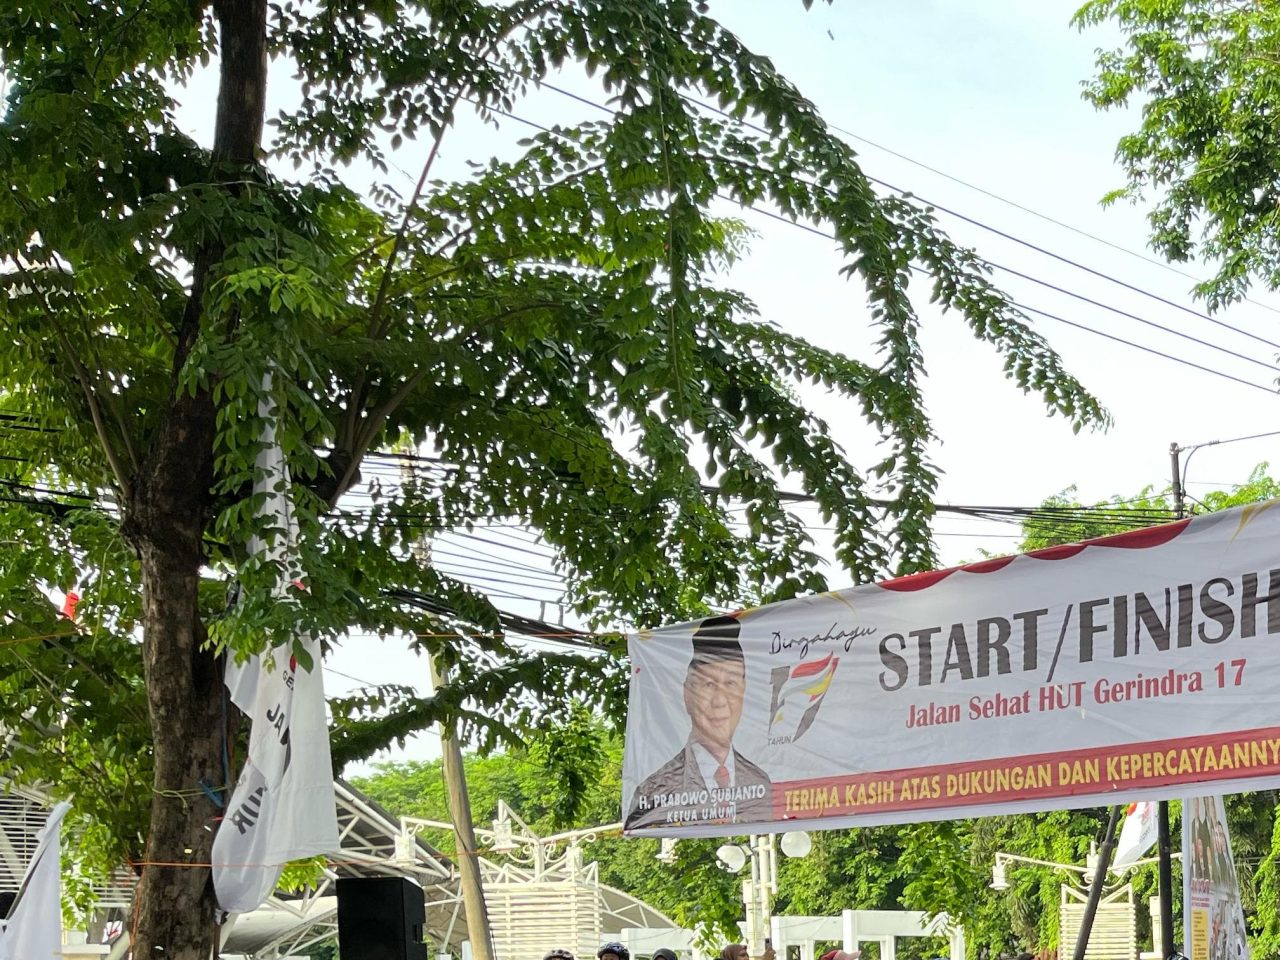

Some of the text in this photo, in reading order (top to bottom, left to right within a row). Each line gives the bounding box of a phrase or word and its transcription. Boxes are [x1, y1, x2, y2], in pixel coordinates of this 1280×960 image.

[905, 658, 1248, 730] Jalan Sehat HUT Gerindra 17
[767, 735, 792, 746] TAHUN
[638, 784, 767, 810] H. PRABOWO SUBIANTO
[784, 784, 840, 814] TERIMA
[845, 777, 896, 807] KASIH
[898, 773, 942, 802] ATAS
[945, 760, 1054, 797] DUKUNGAN
[1058, 757, 1100, 786] DAN
[666, 808, 698, 823] KETUA
